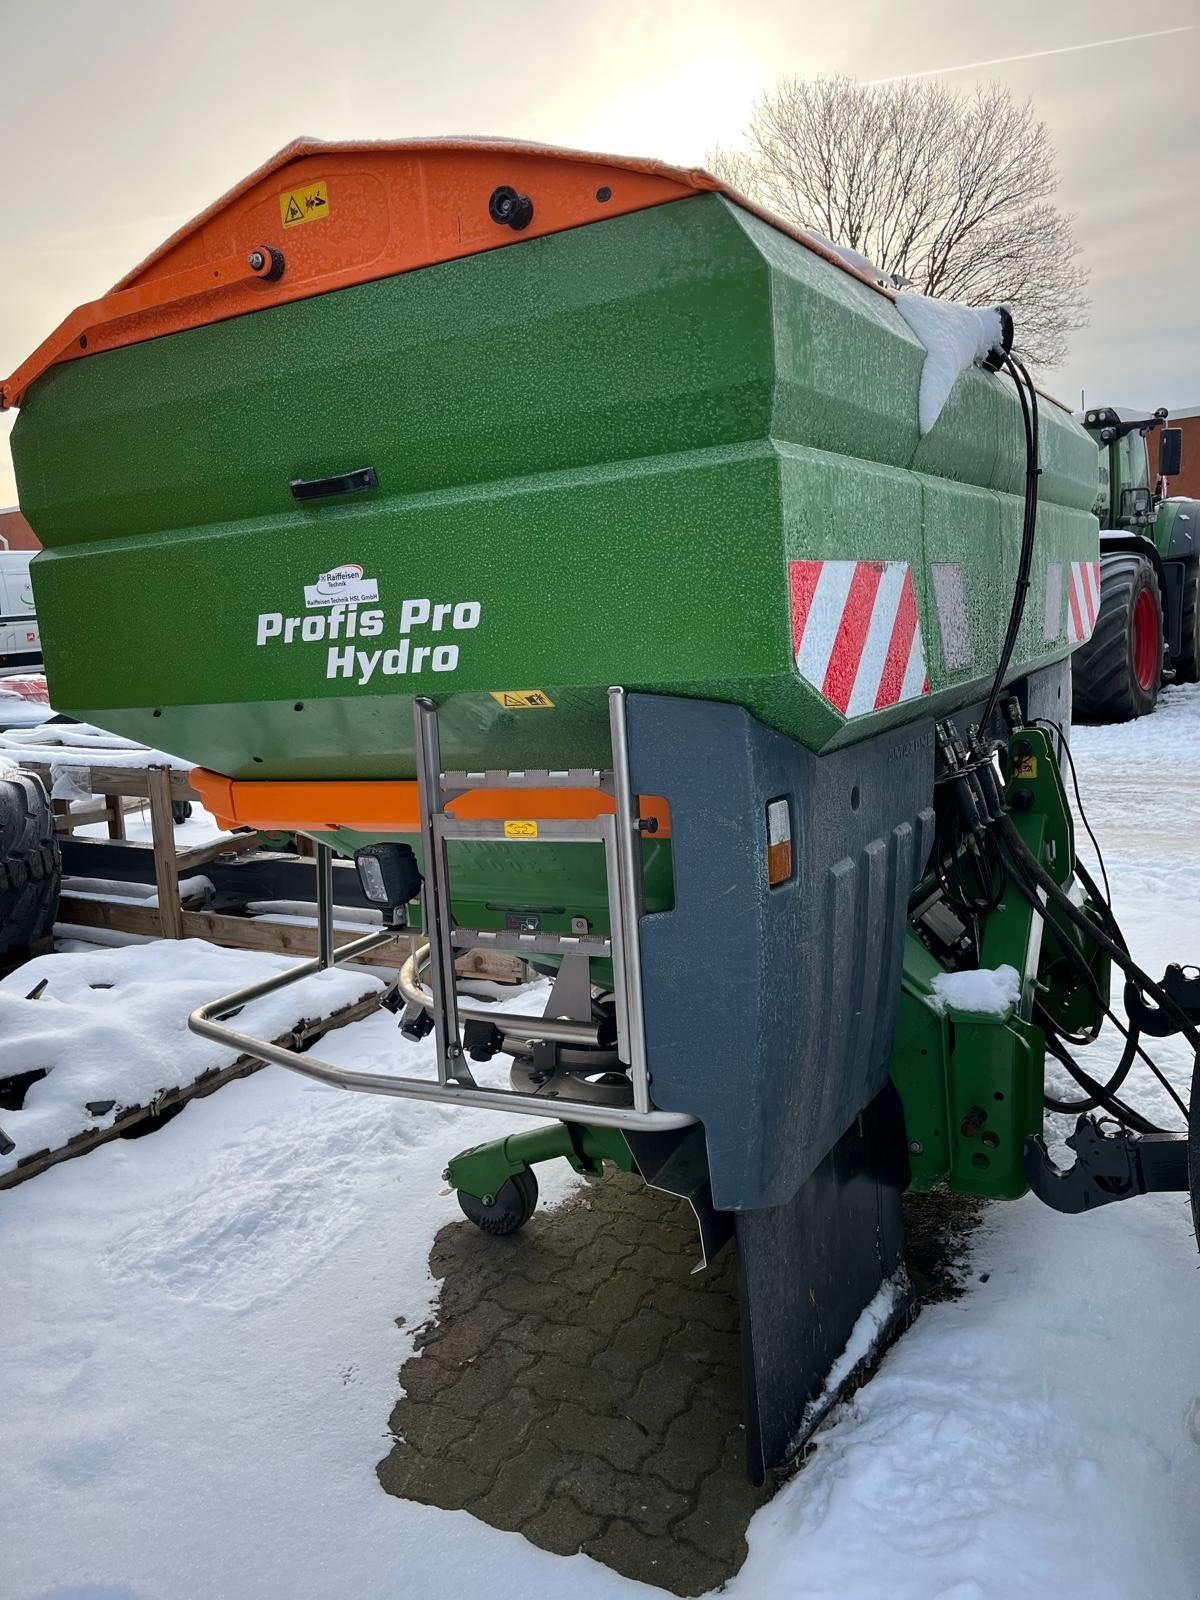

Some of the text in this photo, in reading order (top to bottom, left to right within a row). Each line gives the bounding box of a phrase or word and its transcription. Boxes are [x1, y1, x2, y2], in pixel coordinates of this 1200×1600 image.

[327, 572, 360, 581] Raiffeisen
[307, 598, 331, 606] Raiffeisen
[257, 598, 481, 646] Profis Pro
[326, 639, 459, 686] Hydro
